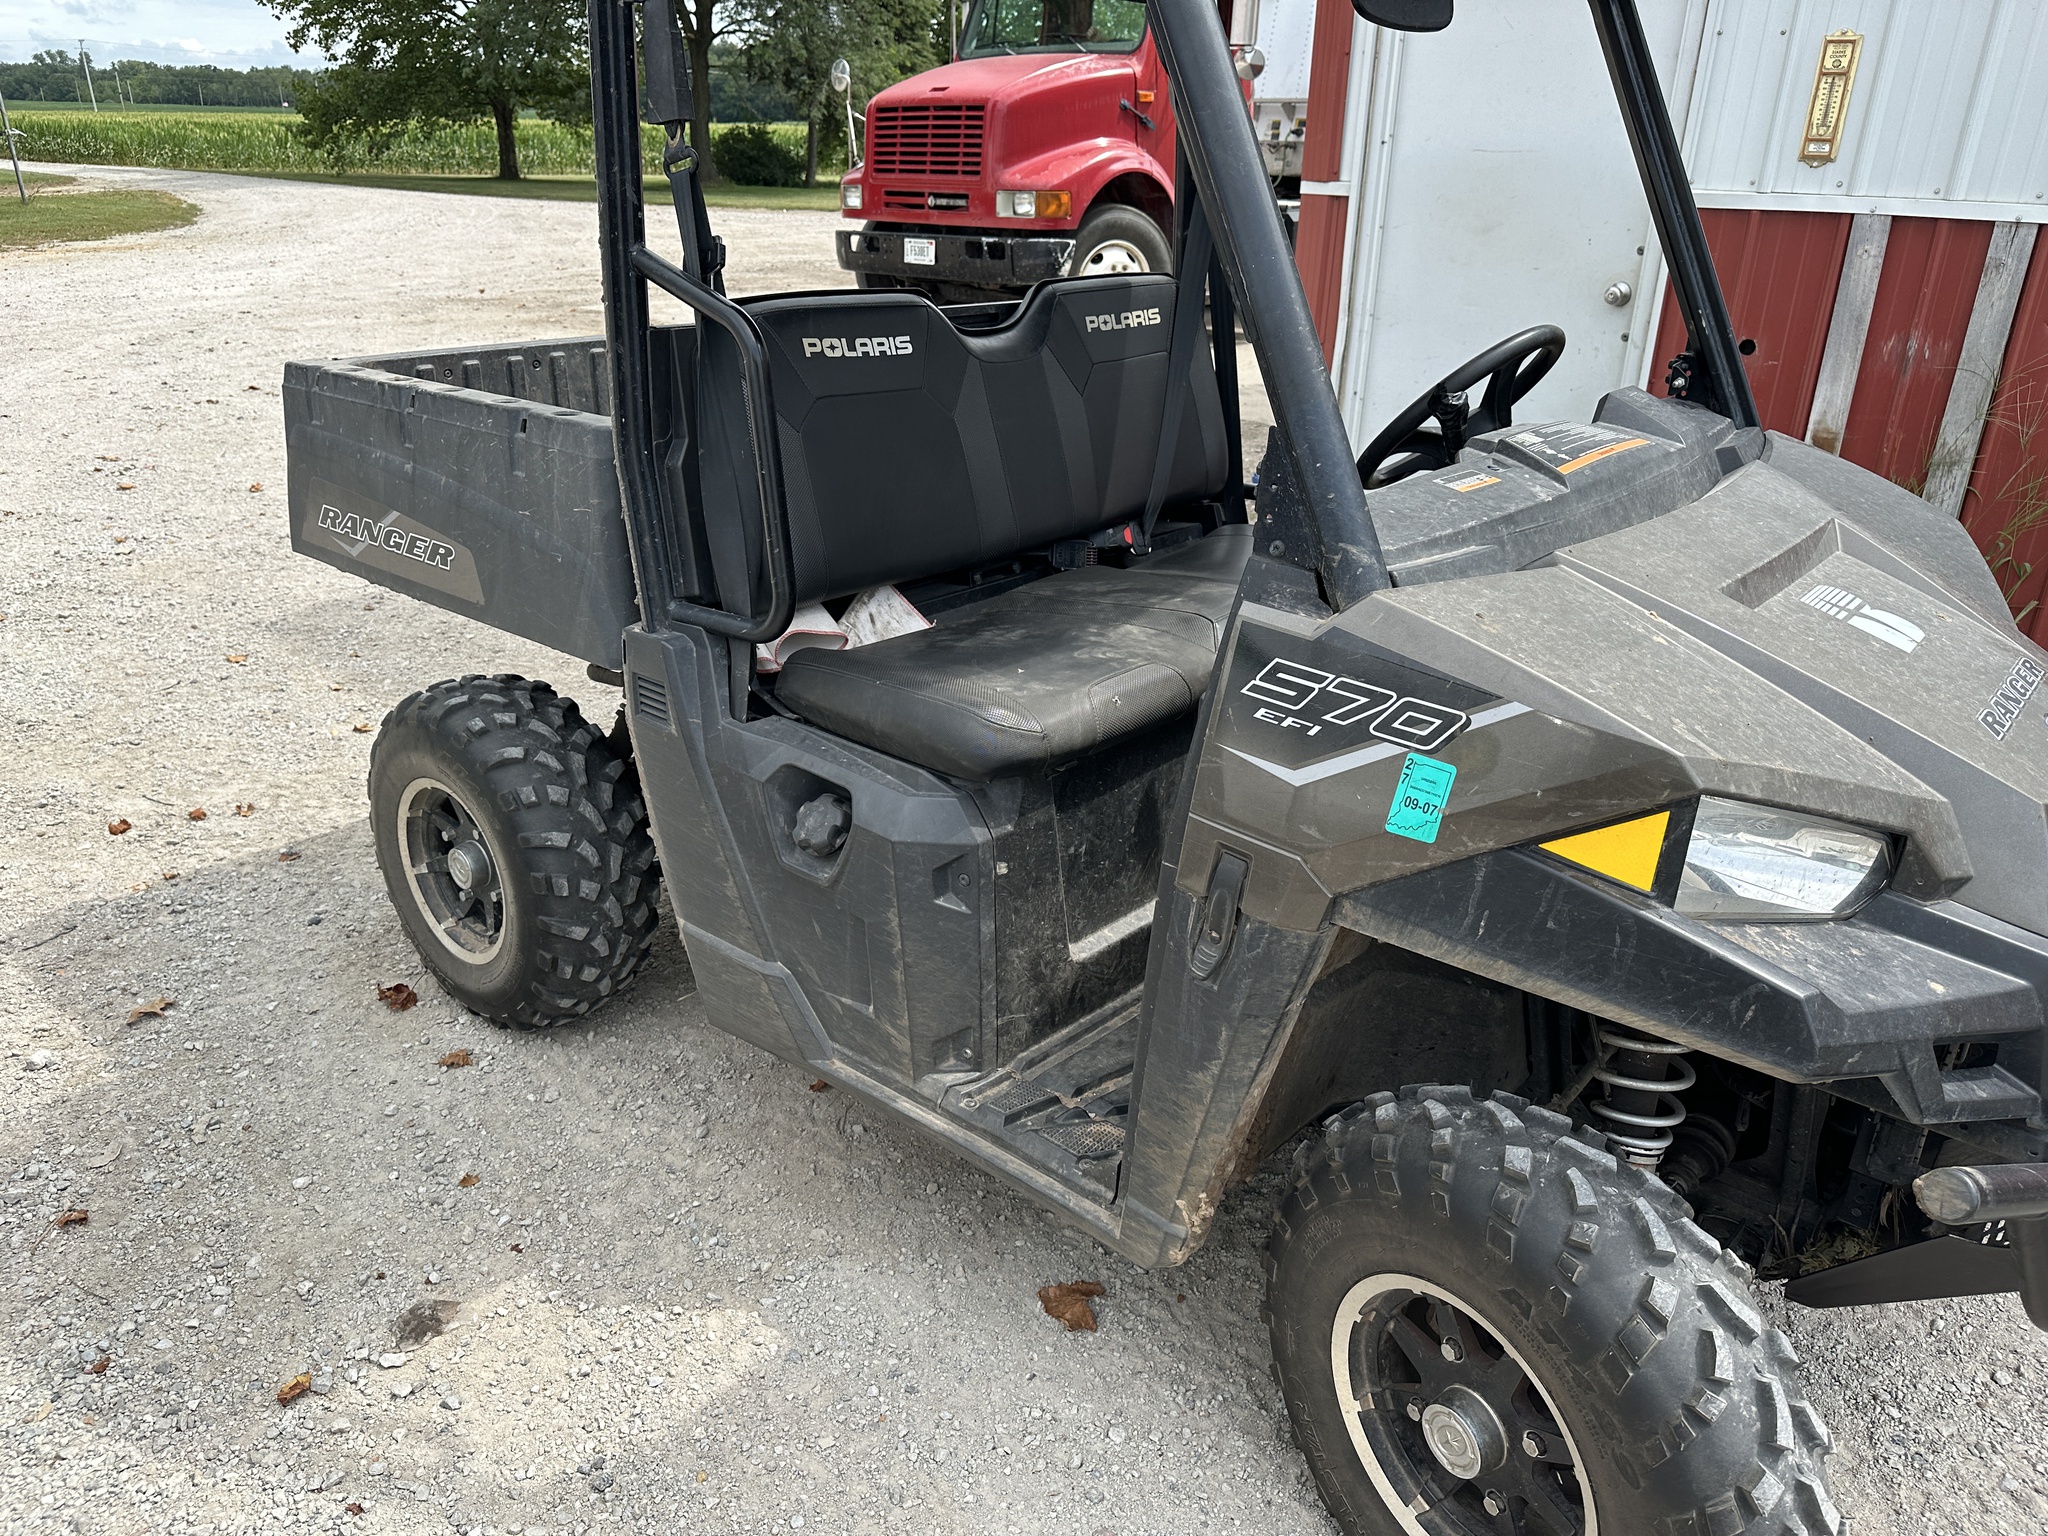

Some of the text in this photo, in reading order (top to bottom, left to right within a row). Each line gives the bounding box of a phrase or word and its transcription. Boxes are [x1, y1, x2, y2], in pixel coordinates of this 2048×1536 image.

[1084, 307, 1161, 332] POLARIS
[802, 335, 913, 358] POLARIS
[318, 504, 455, 571] RANGER
[1239, 656, 1470, 752] 570
[1976, 657, 2045, 741] RANGER
[1252, 707, 1323, 736] EFI
[1403, 795, 1438, 816] 09-07
